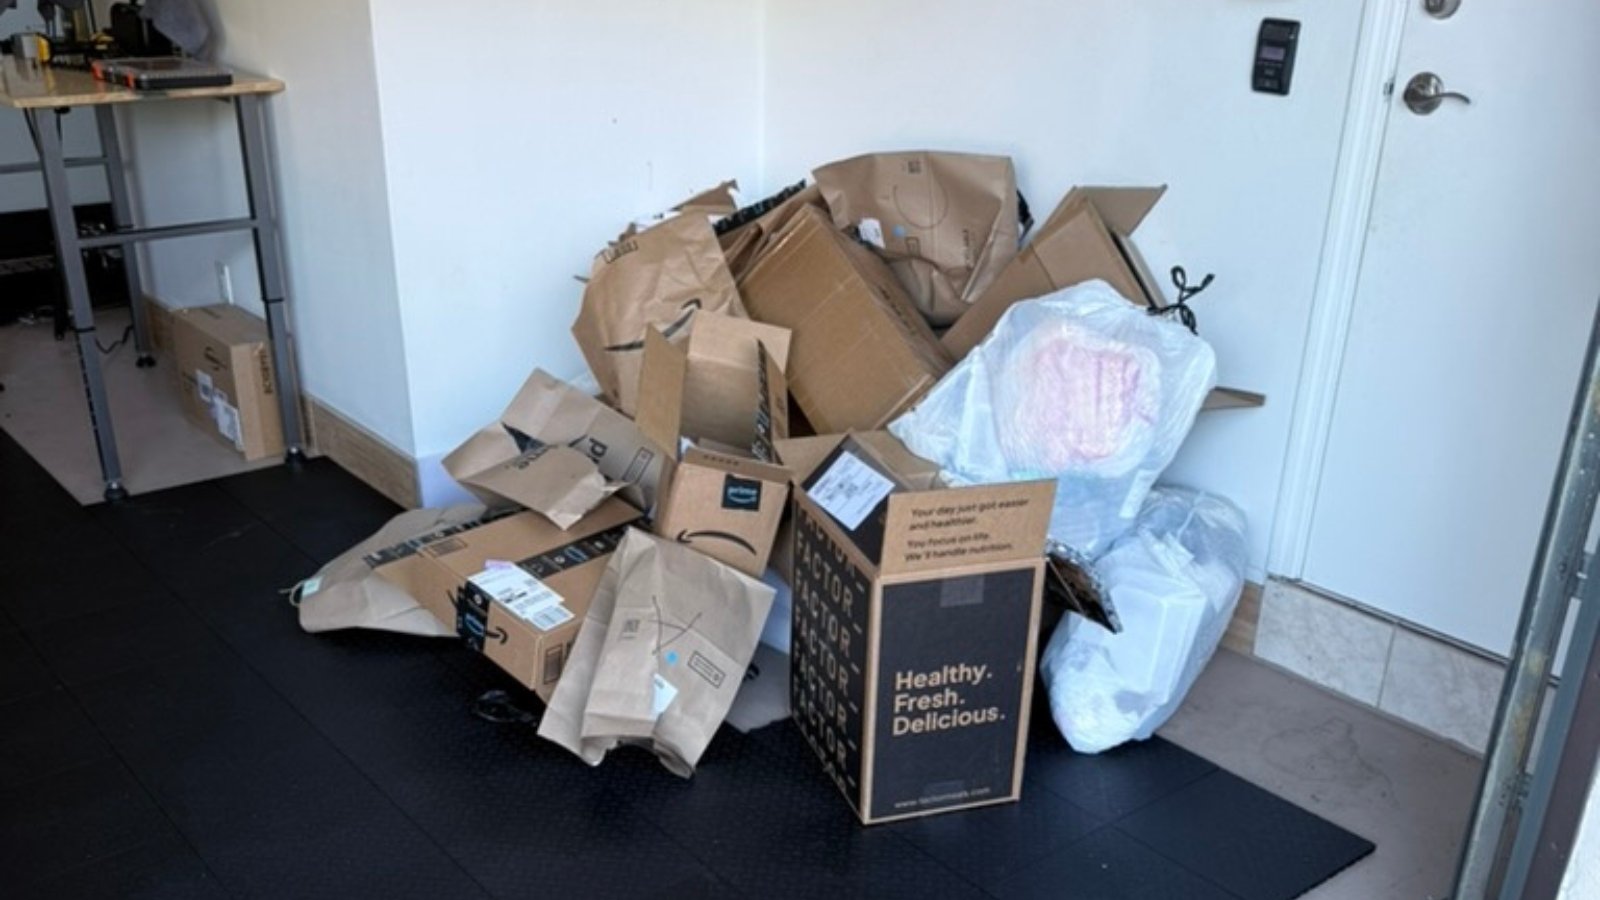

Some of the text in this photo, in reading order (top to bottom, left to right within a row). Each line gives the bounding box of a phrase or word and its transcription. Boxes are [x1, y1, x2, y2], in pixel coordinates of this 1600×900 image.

[910, 498, 1029, 519] Your day just got easier
[909, 521, 930, 531] and
[907, 539, 927, 549] You
[928, 536, 957, 548] focus
[958, 535, 972, 544] on
[932, 546, 966, 558] handle
[895, 662, 993, 691] Healthy.
[893, 687, 966, 714] Fresh.
[892, 706, 1006, 737] Delicious.
